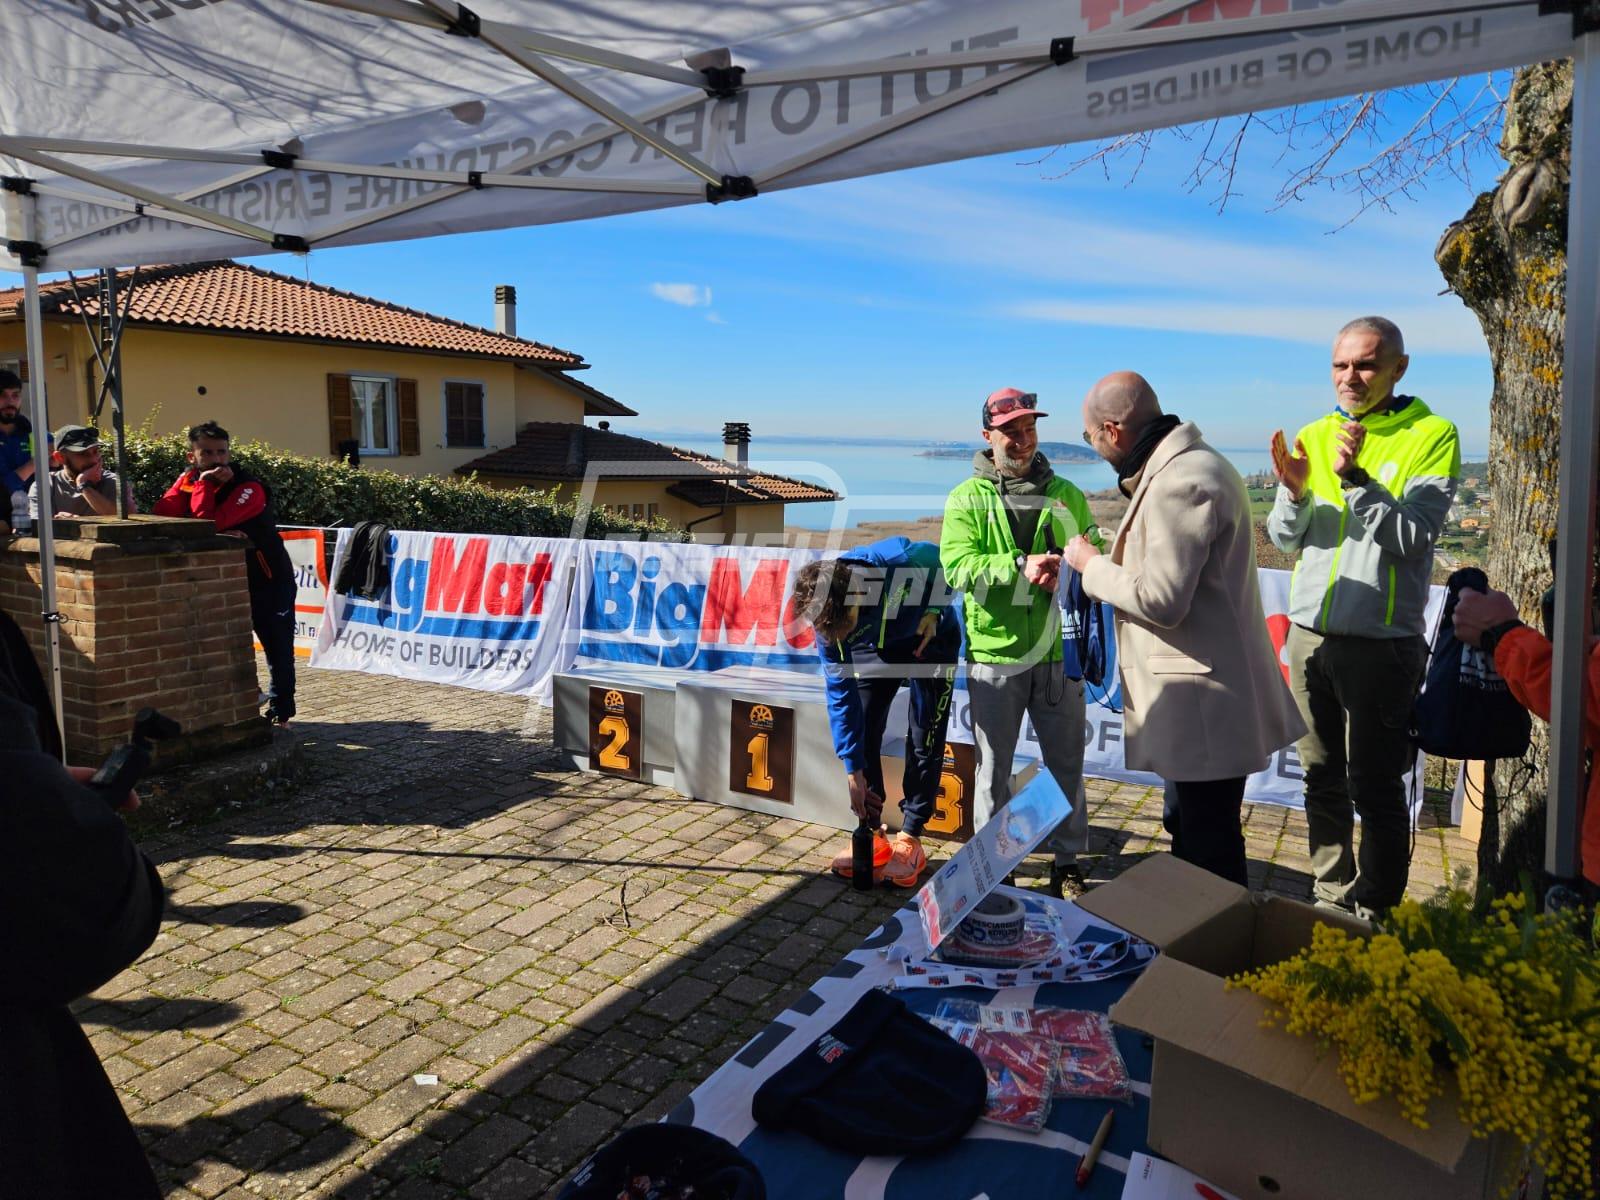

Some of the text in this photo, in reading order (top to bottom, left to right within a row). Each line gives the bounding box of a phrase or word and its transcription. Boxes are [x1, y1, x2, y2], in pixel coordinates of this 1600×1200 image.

[383, 534, 553, 633] igMat
[334, 626, 533, 671] HOME OF BUILDERS
[598, 715, 630, 769] 2
[746, 732, 774, 793] 1
[925, 771, 964, 834] 3
